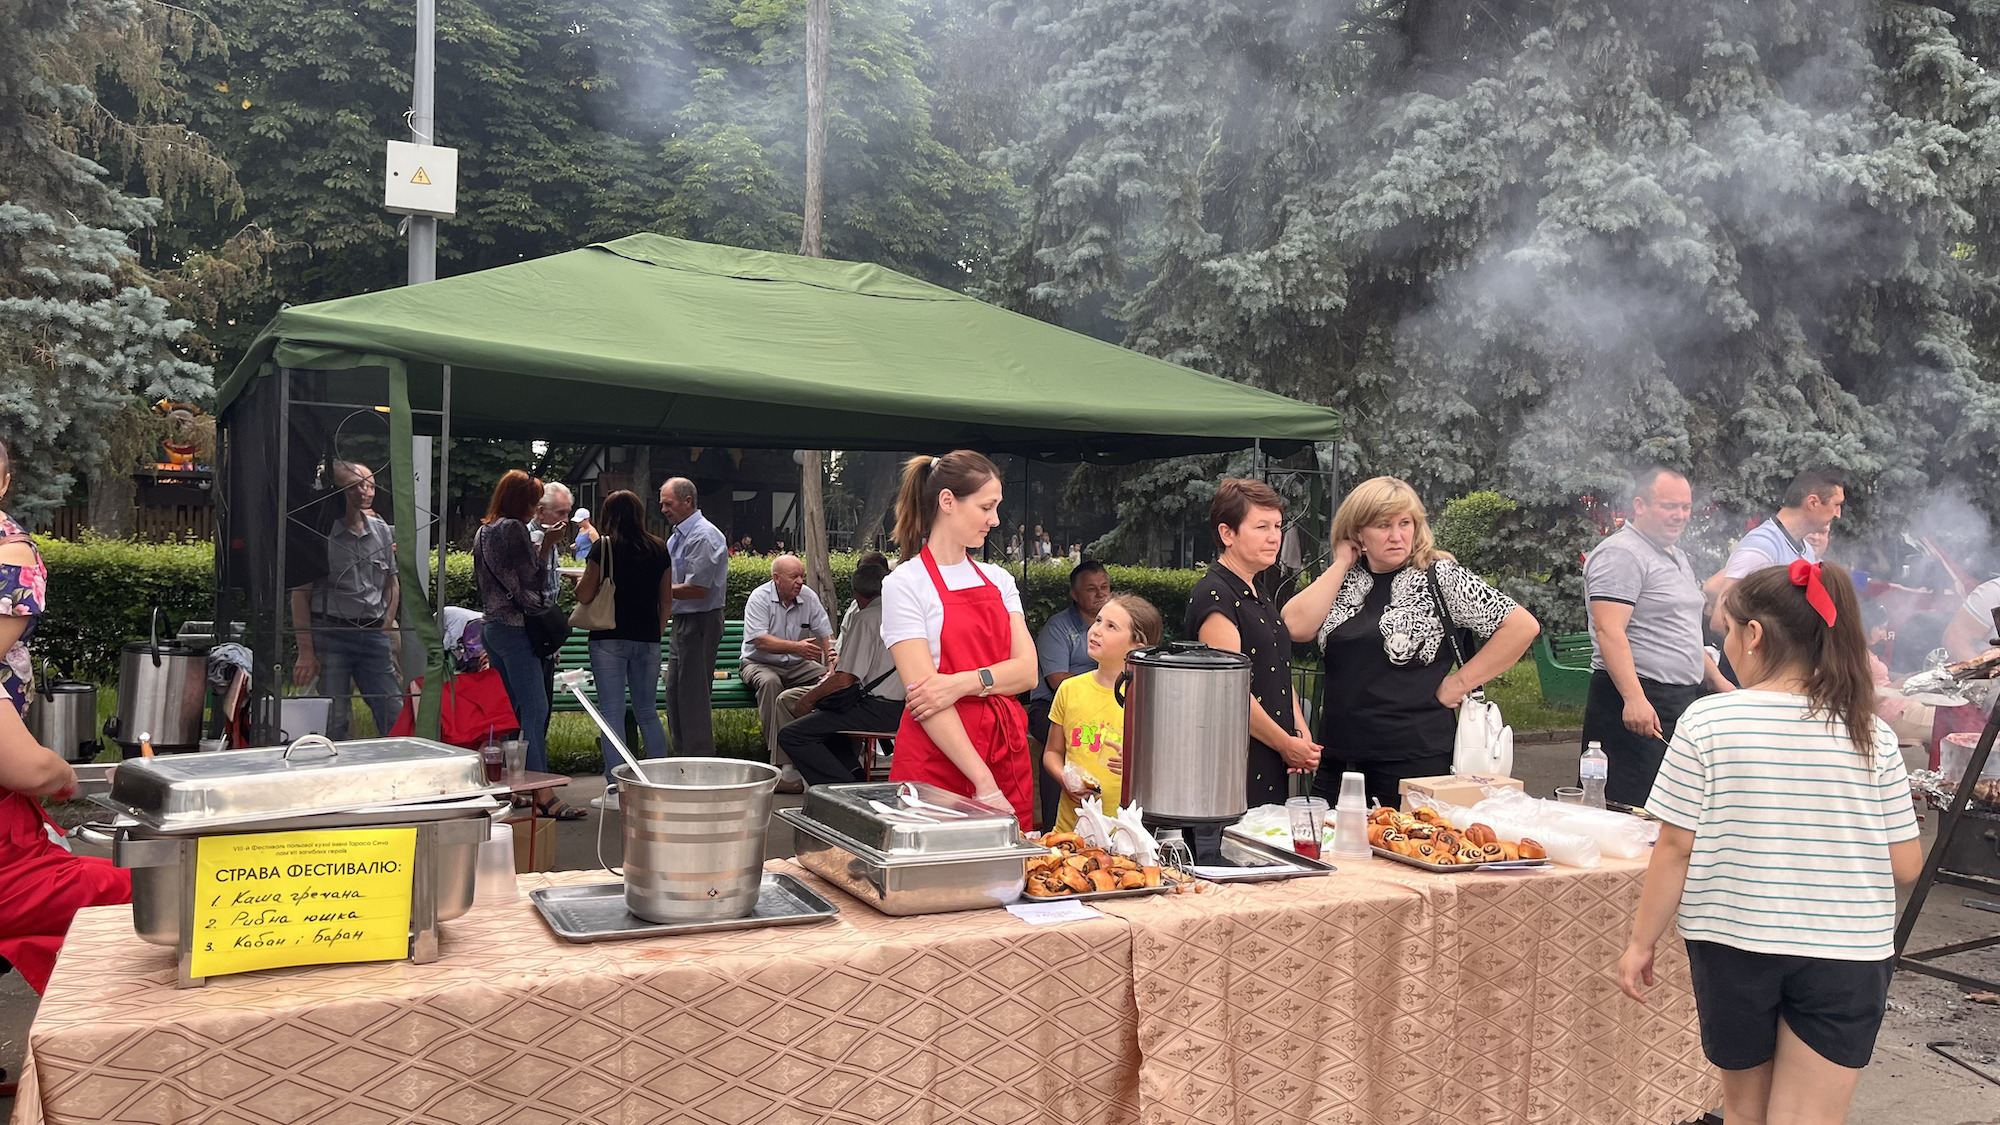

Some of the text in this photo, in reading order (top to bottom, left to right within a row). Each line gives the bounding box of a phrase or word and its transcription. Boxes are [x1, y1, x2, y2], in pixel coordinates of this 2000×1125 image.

[299, 848, 326, 856] загиблих
[215, 860, 402, 882] СТРАВА ФЕСТИВАЛЮ:
[211, 885, 367, 907] 1. Каша гречана
[205, 909, 363, 929] 2. Рибна юшка
[204, 942, 215, 952] 3.
[233, 931, 286, 949] Кабан
[295, 935, 304, 945] і
